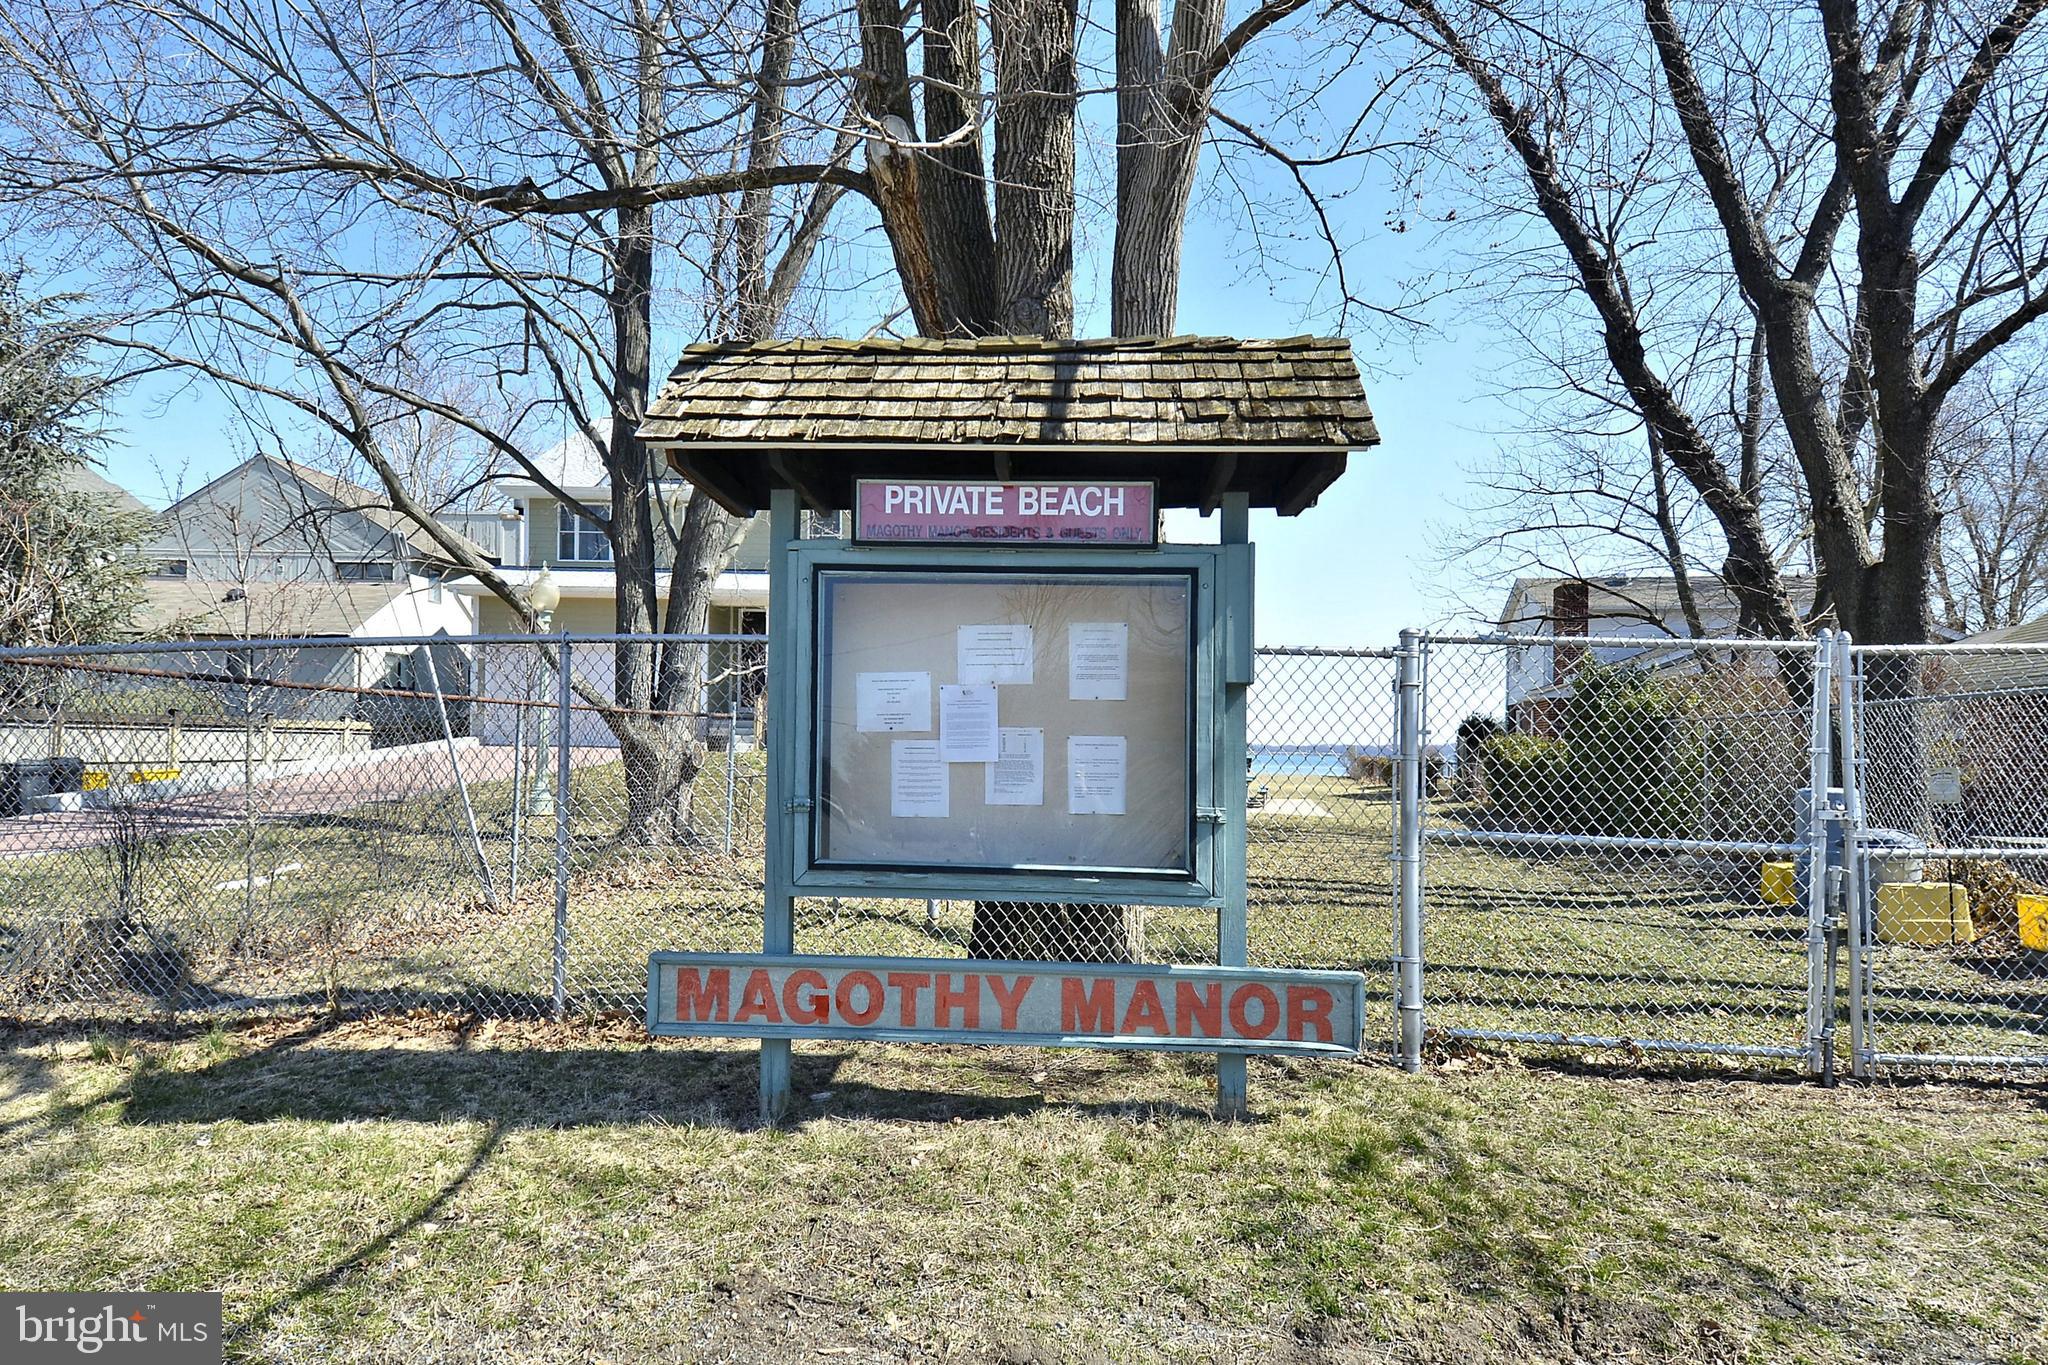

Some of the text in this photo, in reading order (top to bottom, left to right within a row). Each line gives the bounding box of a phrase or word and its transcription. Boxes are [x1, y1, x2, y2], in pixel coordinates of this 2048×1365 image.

[884, 485, 1125, 516] PRIVATE BEACH
[866, 524, 922, 537] MAGOTHY
[1112, 527, 1142, 540] ONLY
[676, 967, 1334, 1042] MAGOTHY MANOR
